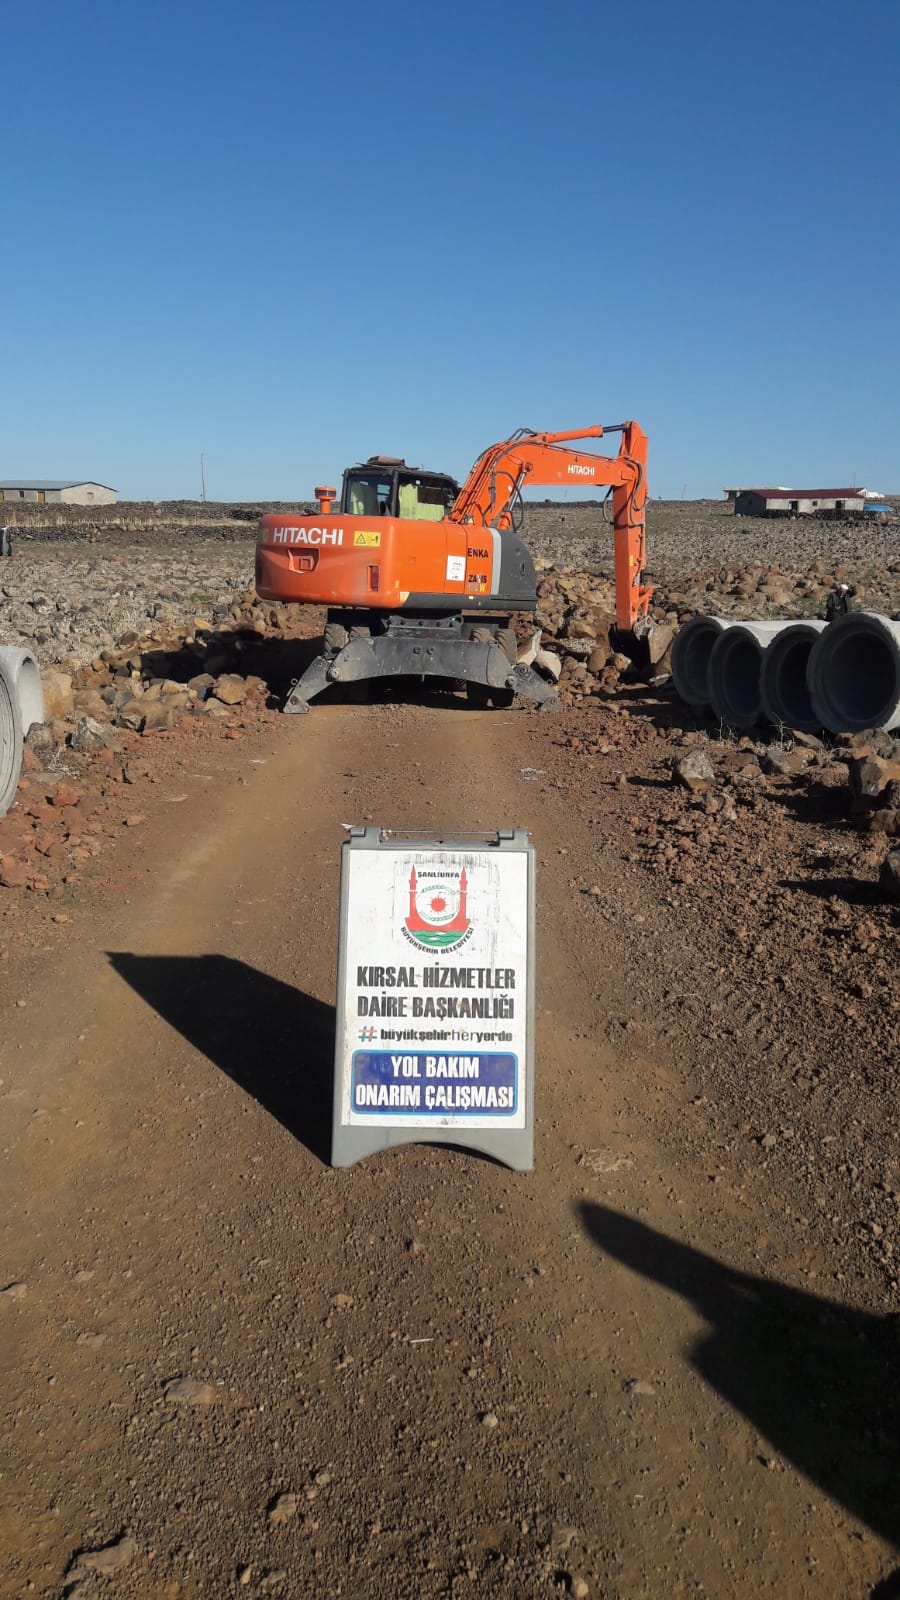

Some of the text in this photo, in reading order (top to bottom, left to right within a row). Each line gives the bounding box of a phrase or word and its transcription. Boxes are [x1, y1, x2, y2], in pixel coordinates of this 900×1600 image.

[567, 464, 595, 476] HITACHI
[273, 527, 344, 545] HITACHI
[467, 548, 488, 558] ENKA
[357, 962, 516, 989] KIRSAL HİZMETLER
[357, 991, 515, 1021] DAİRE BAŞKANLIĞI
[391, 1056, 480, 1078] YOL BAKIM
[355, 1084, 514, 1110] ONARIM ÇALIŞMASI
